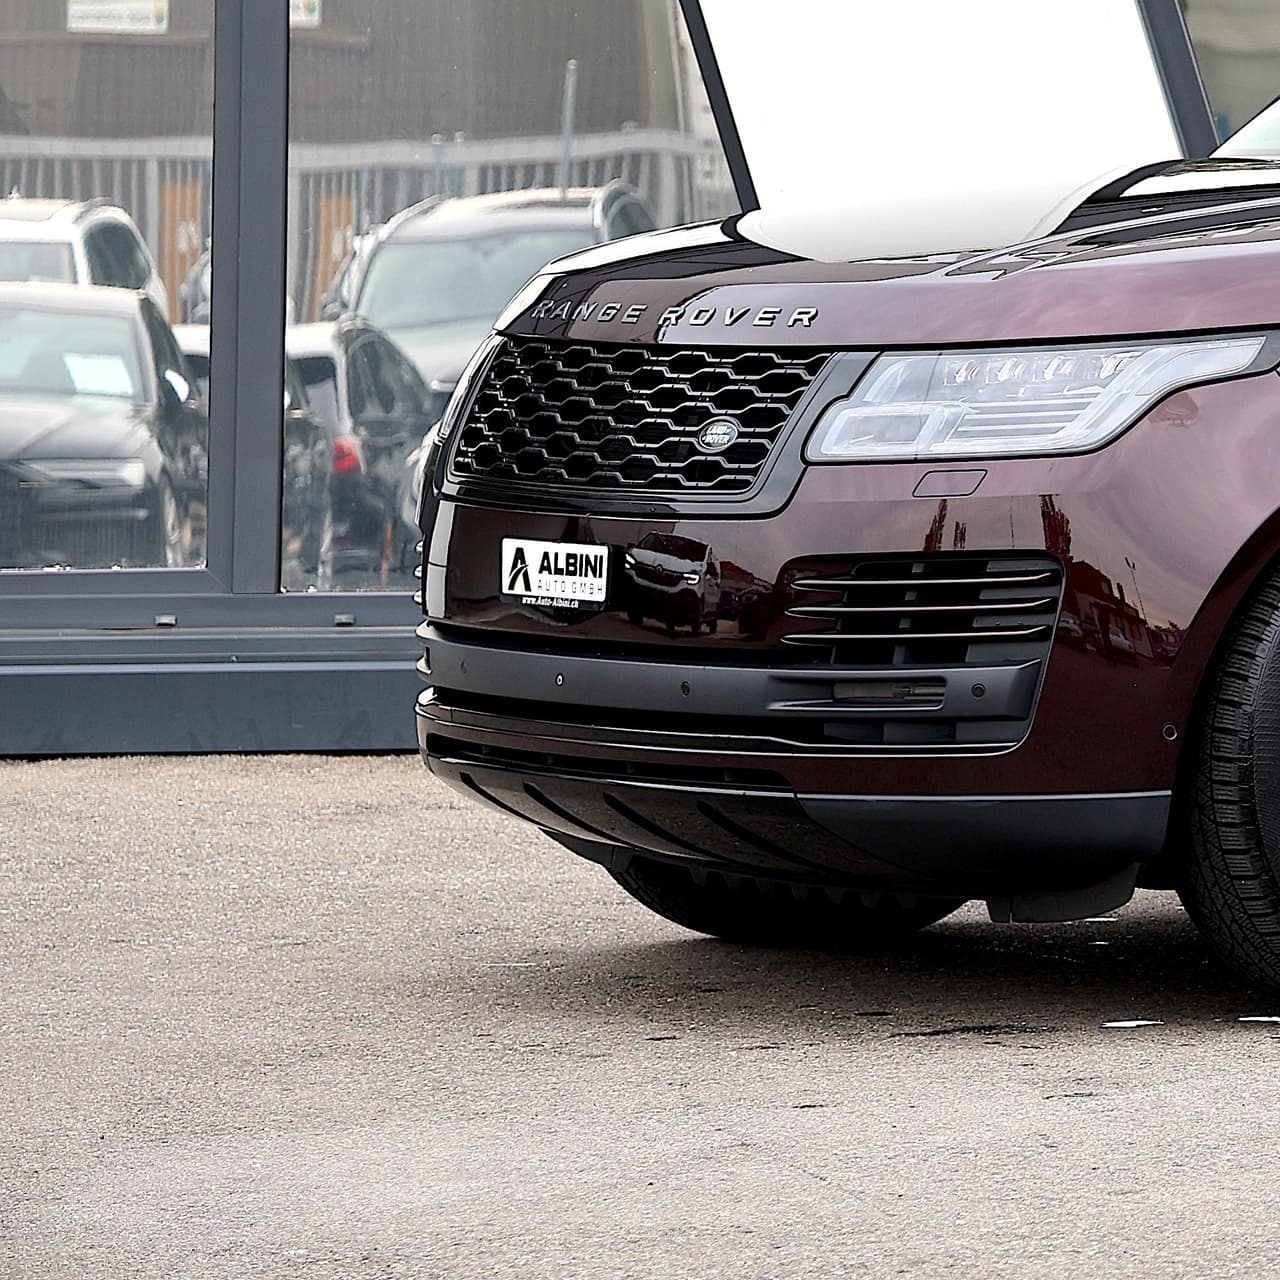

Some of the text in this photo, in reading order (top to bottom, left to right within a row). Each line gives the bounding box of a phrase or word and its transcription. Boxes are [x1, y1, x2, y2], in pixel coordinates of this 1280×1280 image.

[531, 299, 819, 328] RANGE ROVER
[538, 551, 604, 579] ALBINI
[537, 579, 603, 595] AUTO GMBH
